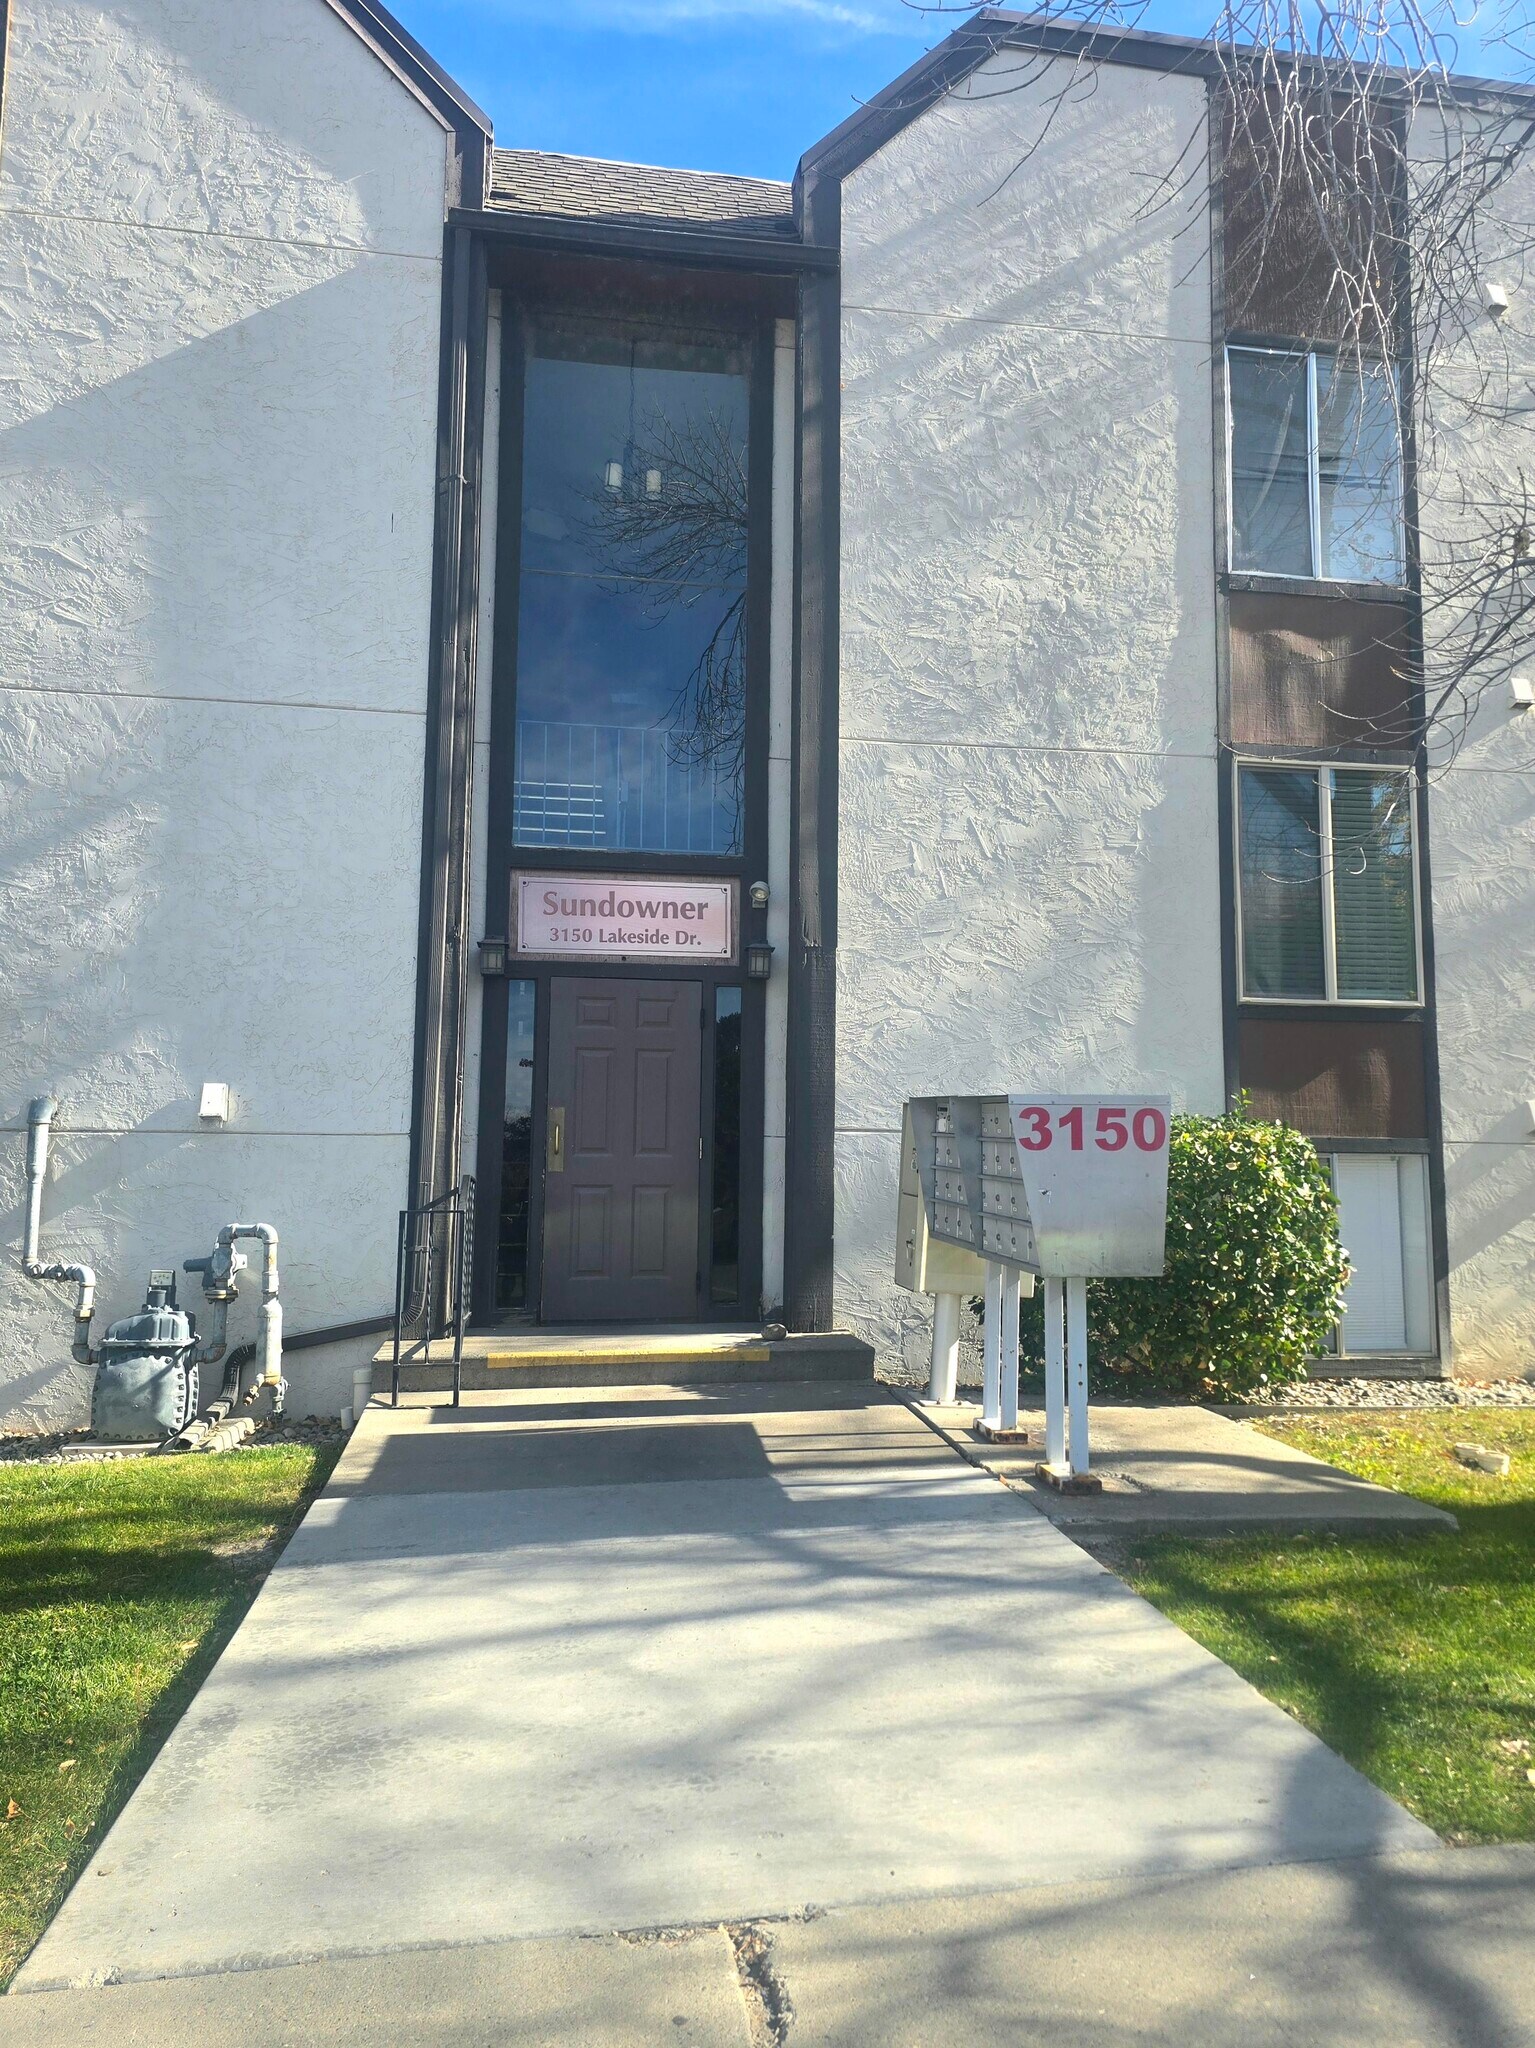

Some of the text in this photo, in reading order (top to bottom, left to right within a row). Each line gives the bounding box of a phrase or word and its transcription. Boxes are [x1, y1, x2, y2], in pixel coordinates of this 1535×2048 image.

[542, 891, 709, 920] Sundowner
[550, 927, 702, 946] 3150 Lakeside Dr.
[1018, 1107, 1166, 1151] 3150
